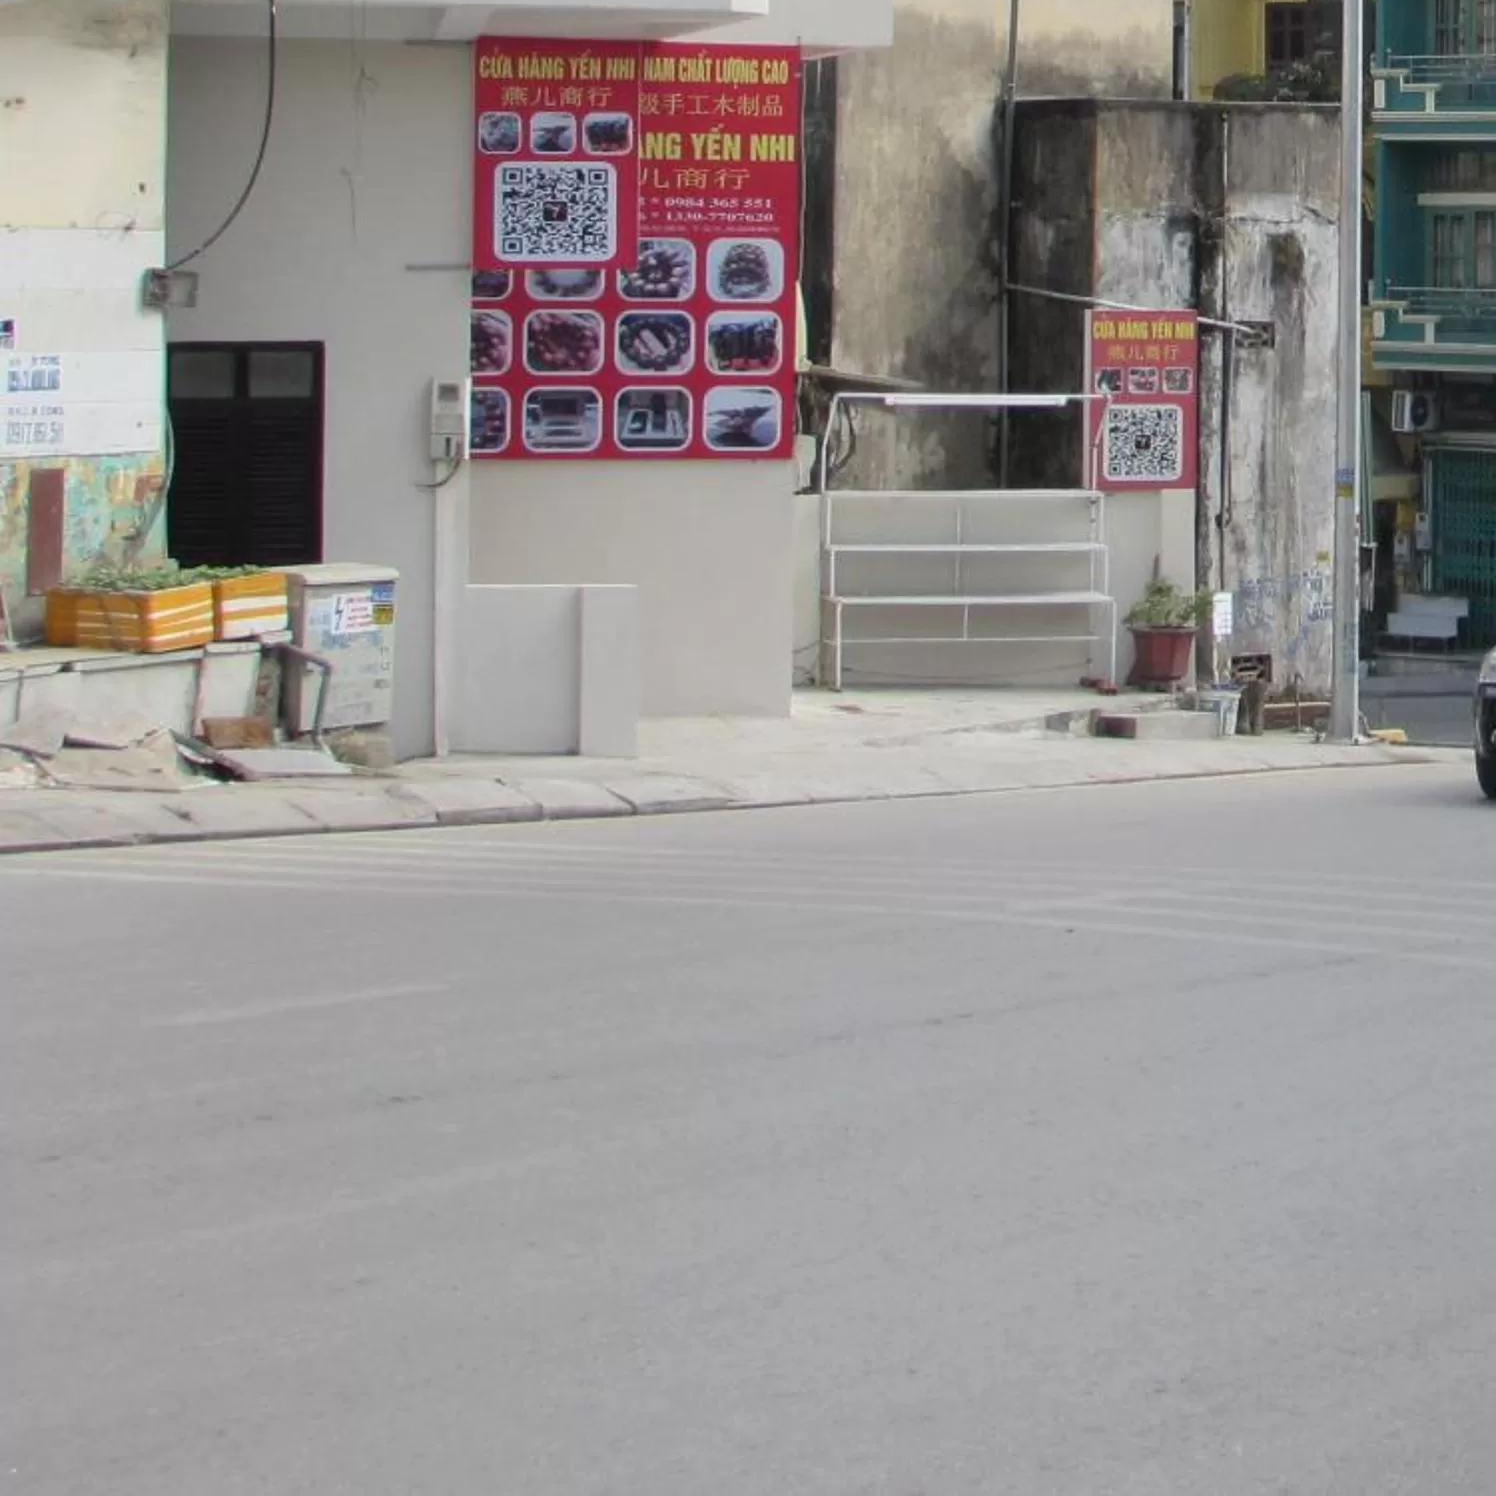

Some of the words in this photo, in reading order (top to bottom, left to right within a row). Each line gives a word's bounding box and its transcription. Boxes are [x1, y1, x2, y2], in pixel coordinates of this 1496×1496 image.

[479, 47, 513, 79] CỬA
[518, 51, 565, 80] HÀNG
[570, 49, 601, 81] YẾN
[606, 56, 635, 81] NHI
[678, 49, 712, 83] CHẤT
[716, 56, 759, 90] LƯỢNG
[762, 59, 789, 85] CAO
[691, 123, 741, 161] YẾN
[750, 134, 795, 162] NHI
